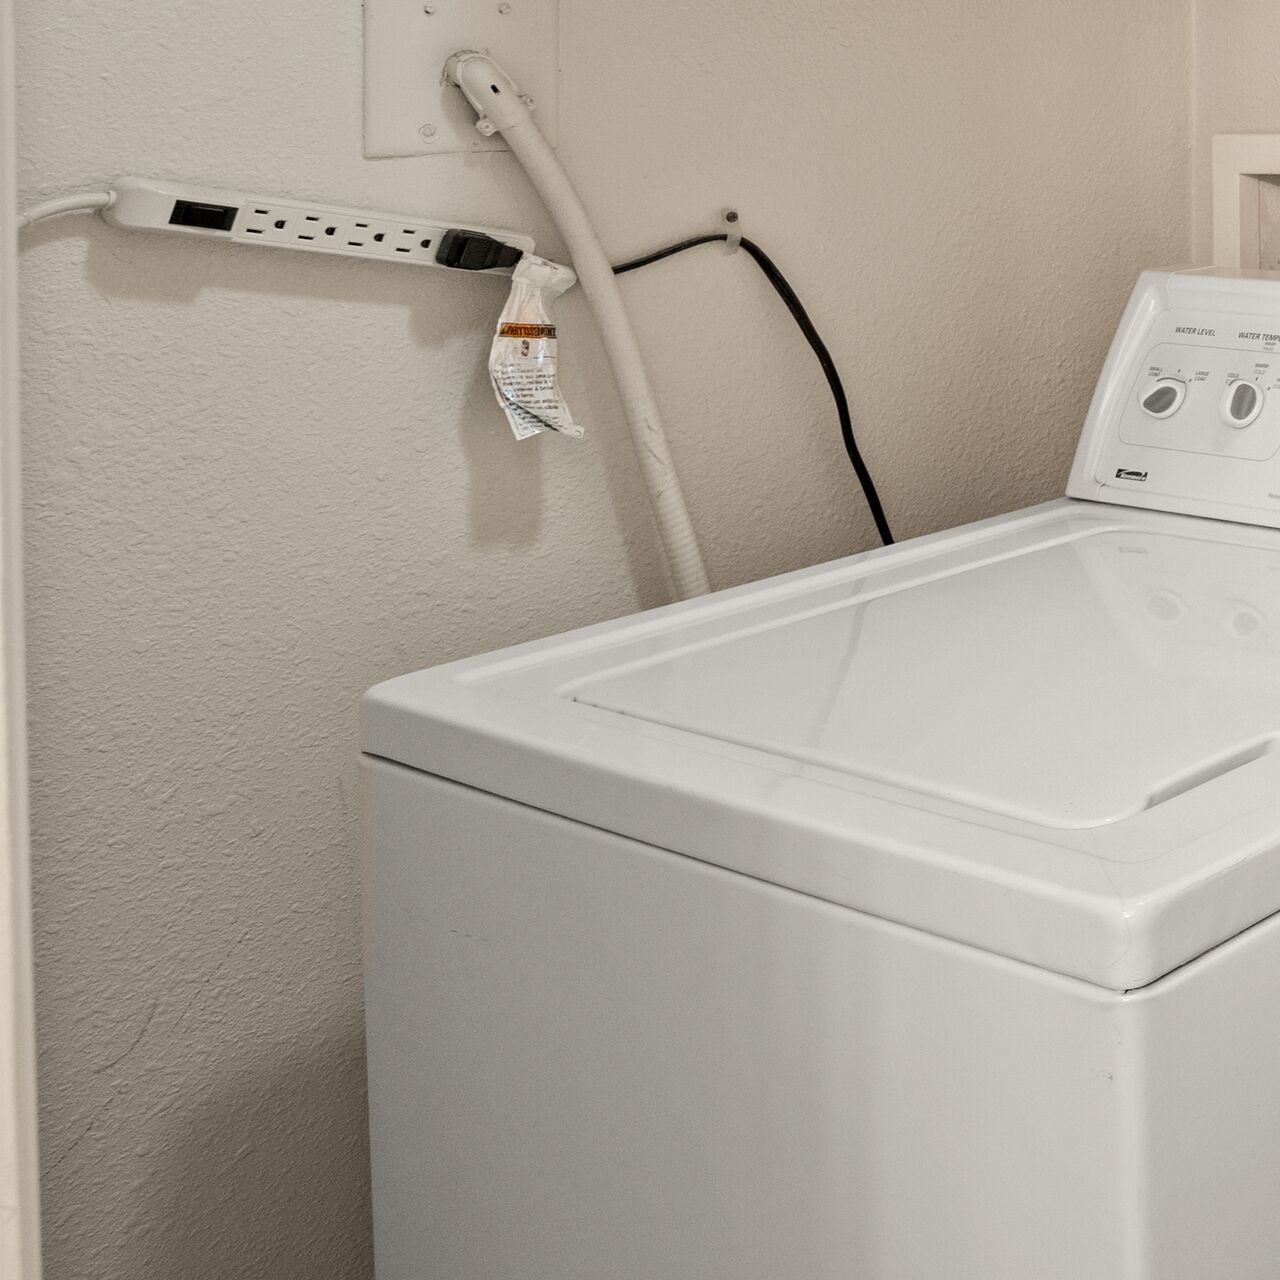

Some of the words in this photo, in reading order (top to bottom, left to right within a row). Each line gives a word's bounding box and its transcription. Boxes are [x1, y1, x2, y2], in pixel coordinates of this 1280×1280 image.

[1175, 327, 1196, 336] WATER
[1196, 328, 1216, 337] LEVEL
[1238, 332, 1261, 341] WATER
